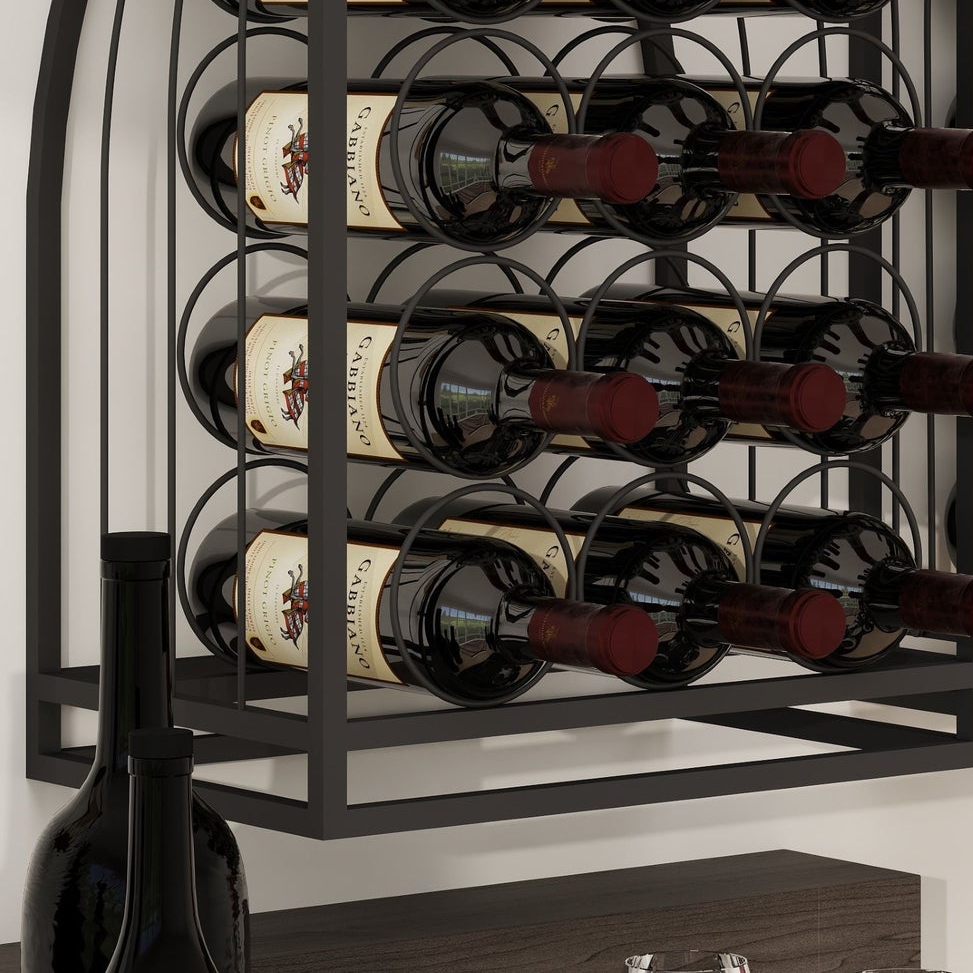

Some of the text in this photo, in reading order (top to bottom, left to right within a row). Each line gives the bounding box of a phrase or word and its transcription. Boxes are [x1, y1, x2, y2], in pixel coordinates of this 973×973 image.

[262, 114, 277, 152] PINOT
[346, 106, 372, 217] GABBIANO
[262, 157, 277, 203] GRIGIO
[263, 340, 278, 428] PINOT GRIGIO
[347, 335, 373, 447] GABBIANO
[262, 557, 277, 646] PINOT GRIGIO
[346, 558, 372, 670] GABBIANO
